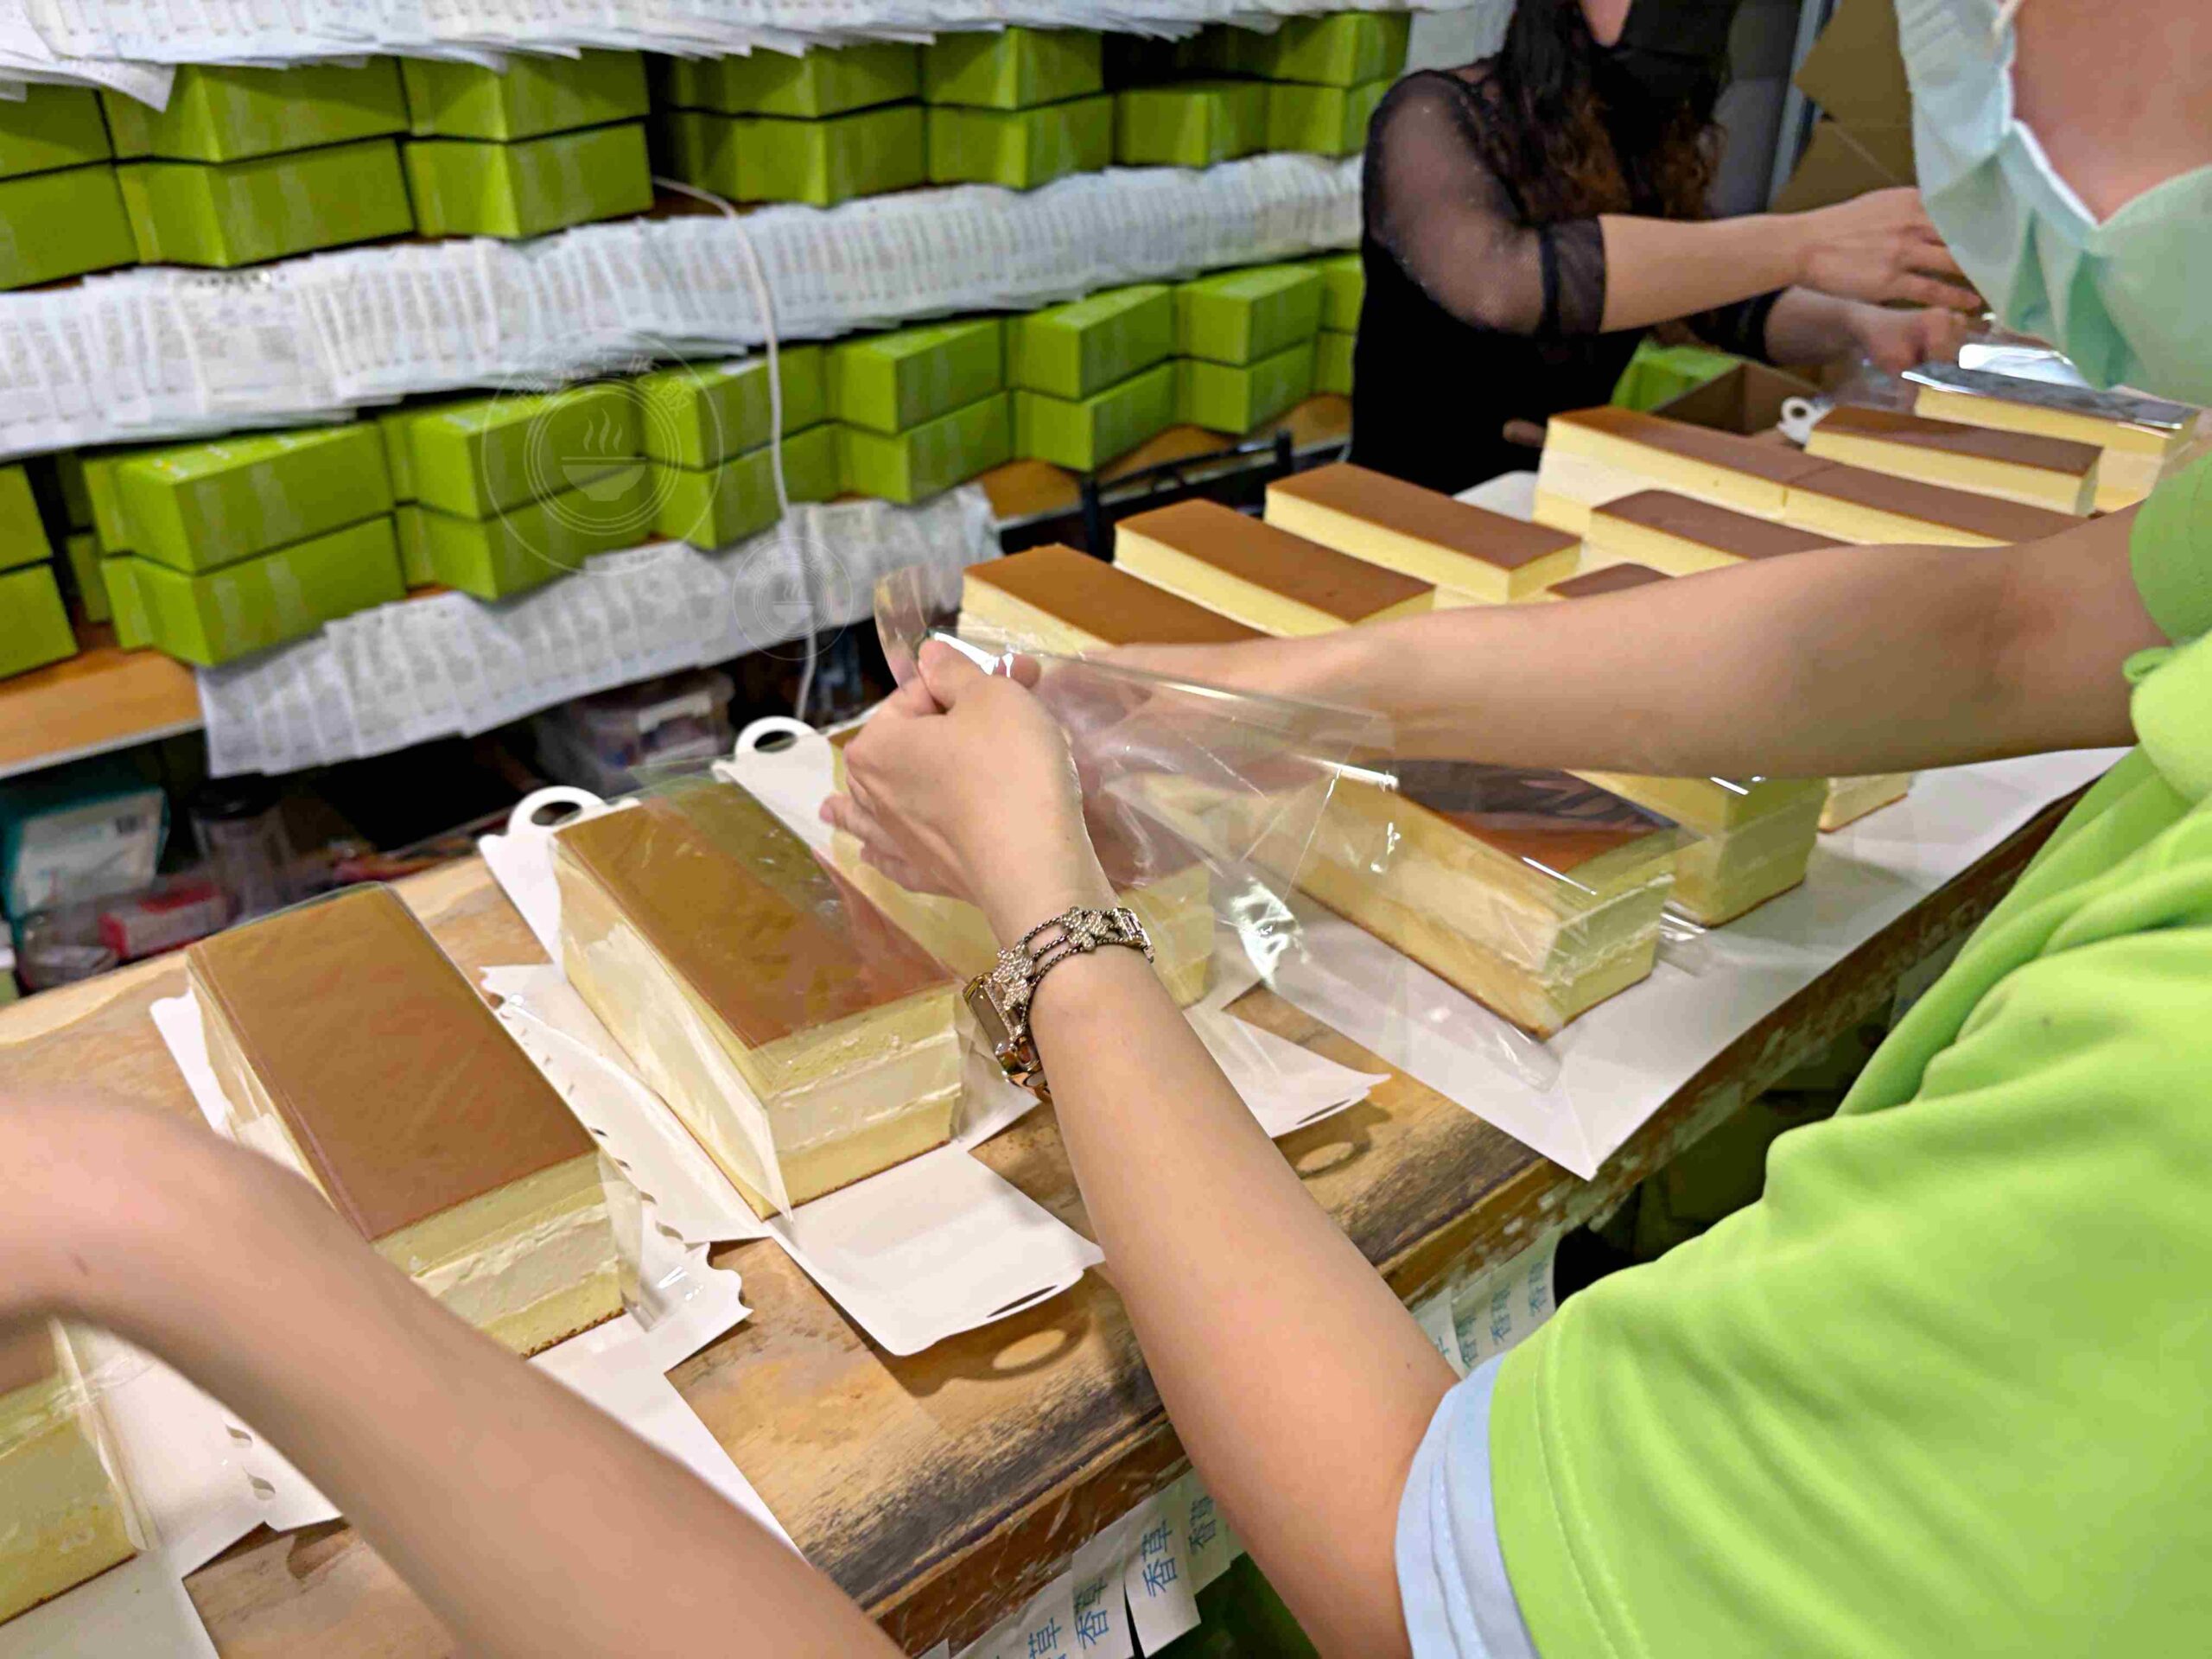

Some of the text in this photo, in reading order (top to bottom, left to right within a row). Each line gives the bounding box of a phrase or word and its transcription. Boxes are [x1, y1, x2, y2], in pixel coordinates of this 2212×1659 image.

[1141, 1520, 1178, 1597] 香草
[1027, 1617, 1067, 1659] 草
[1073, 1575, 1109, 1650] 香草
